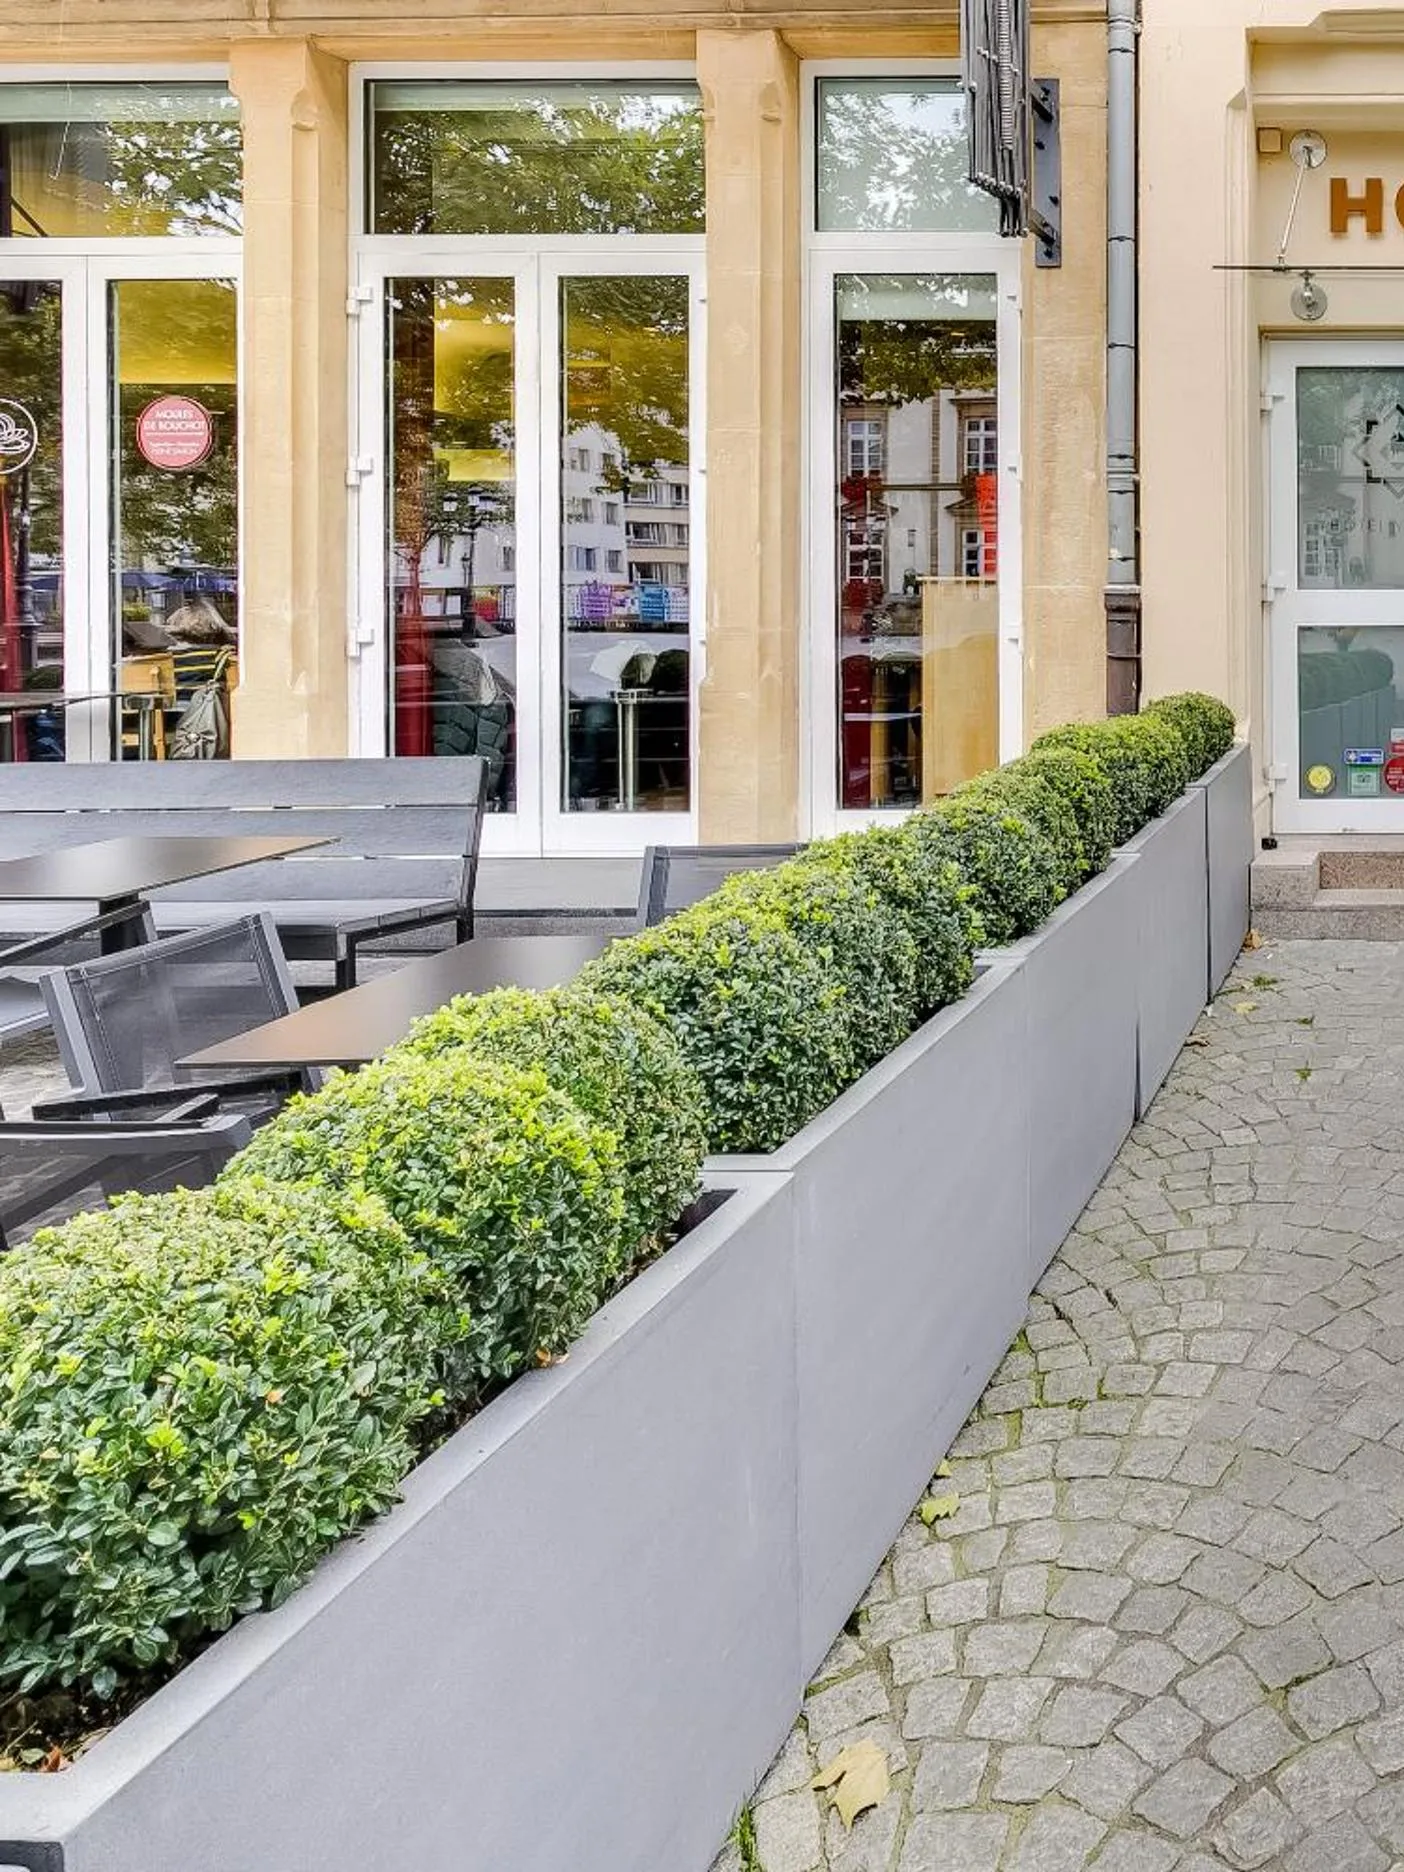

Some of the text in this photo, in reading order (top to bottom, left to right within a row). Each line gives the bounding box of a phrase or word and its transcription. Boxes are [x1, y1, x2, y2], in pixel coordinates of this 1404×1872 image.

[155, 409, 194, 419] MOULES
[143, 420, 205, 431] DE BOUCHOT
[1330, 519, 1384, 532] HOEL
